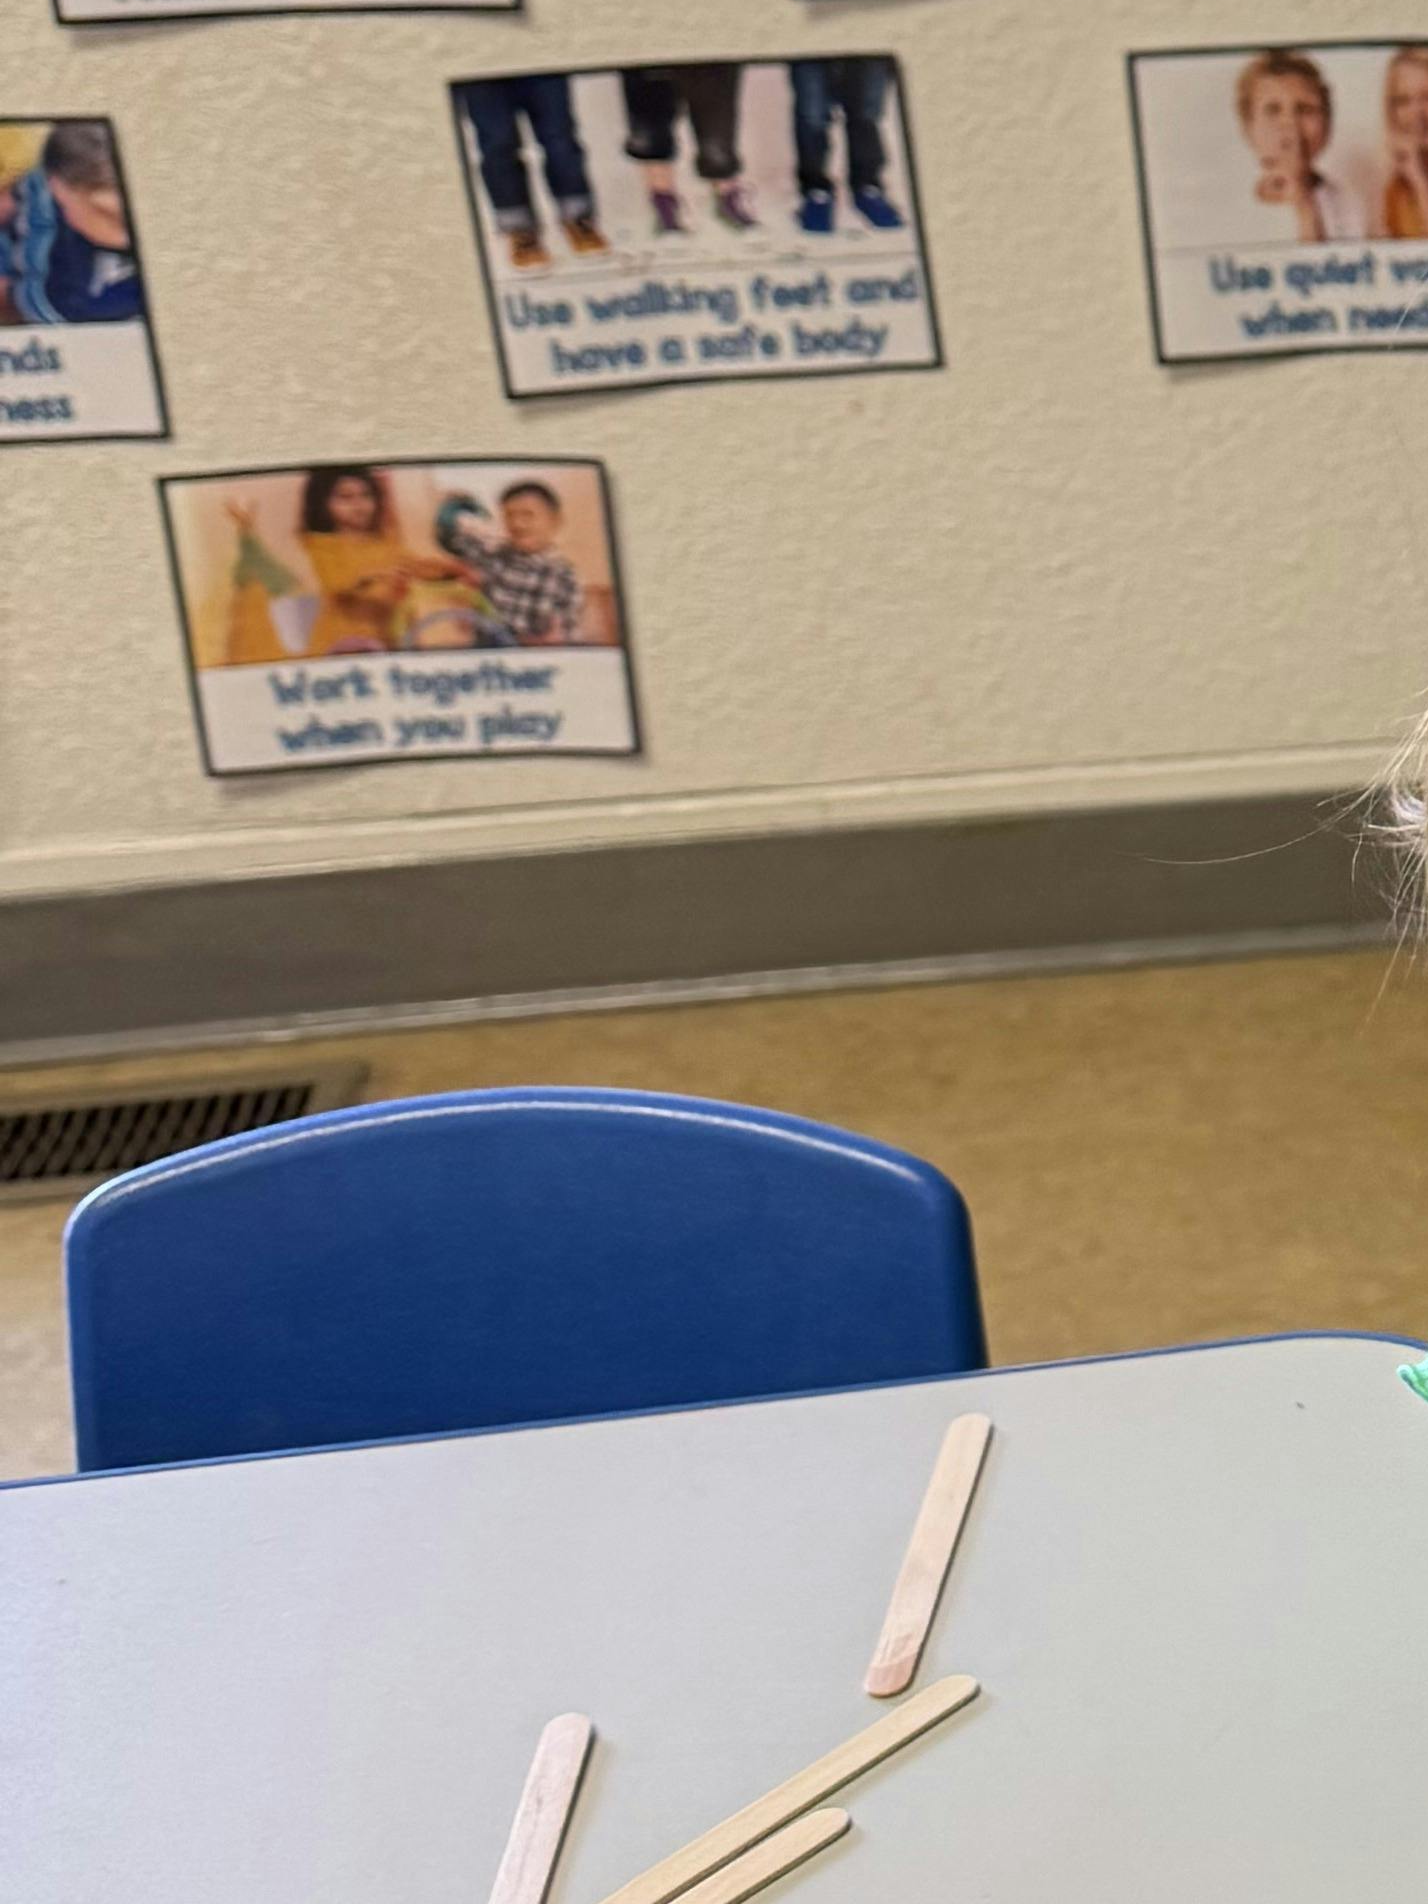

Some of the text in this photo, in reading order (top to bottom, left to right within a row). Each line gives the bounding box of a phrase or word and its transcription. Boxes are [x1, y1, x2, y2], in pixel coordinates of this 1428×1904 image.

[1209, 253, 1272, 292] Use
[1285, 251, 1376, 298] quiet
[507, 271, 917, 329] Use walking feet and
[1240, 299, 1337, 339] when
[550, 315, 888, 375] have a safe body
[268, 663, 558, 710] Work together
[278, 707, 562, 752] when you play
